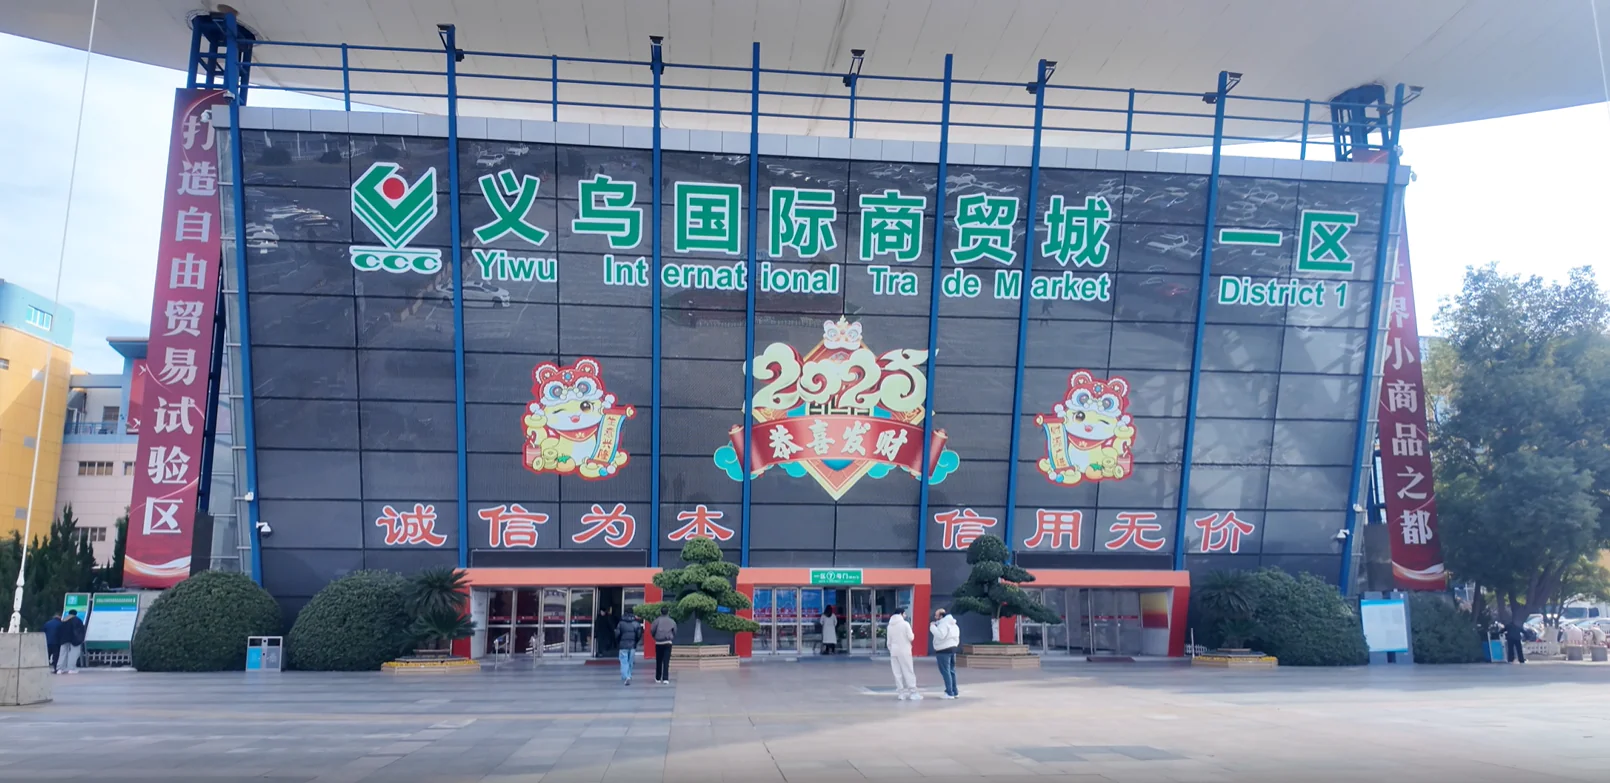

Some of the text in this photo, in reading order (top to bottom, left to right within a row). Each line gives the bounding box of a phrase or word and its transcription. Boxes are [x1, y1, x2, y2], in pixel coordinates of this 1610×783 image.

[474, 170, 1358, 273] 义乌国际商贸城 一区
[475, 250, 557, 282] Yiwu
[869, 266, 981, 297] Trade
[995, 270, 1109, 301] Market
[1219, 276, 1324, 306] District
[1334, 283, 1348, 307] 1
[143, 114, 217, 535] 打造自由贸易试验区
[769, 419, 908, 462] 恭喜发财
[375, 503, 734, 548] 诚信为本
[934, 508, 1255, 553] 信用无价
